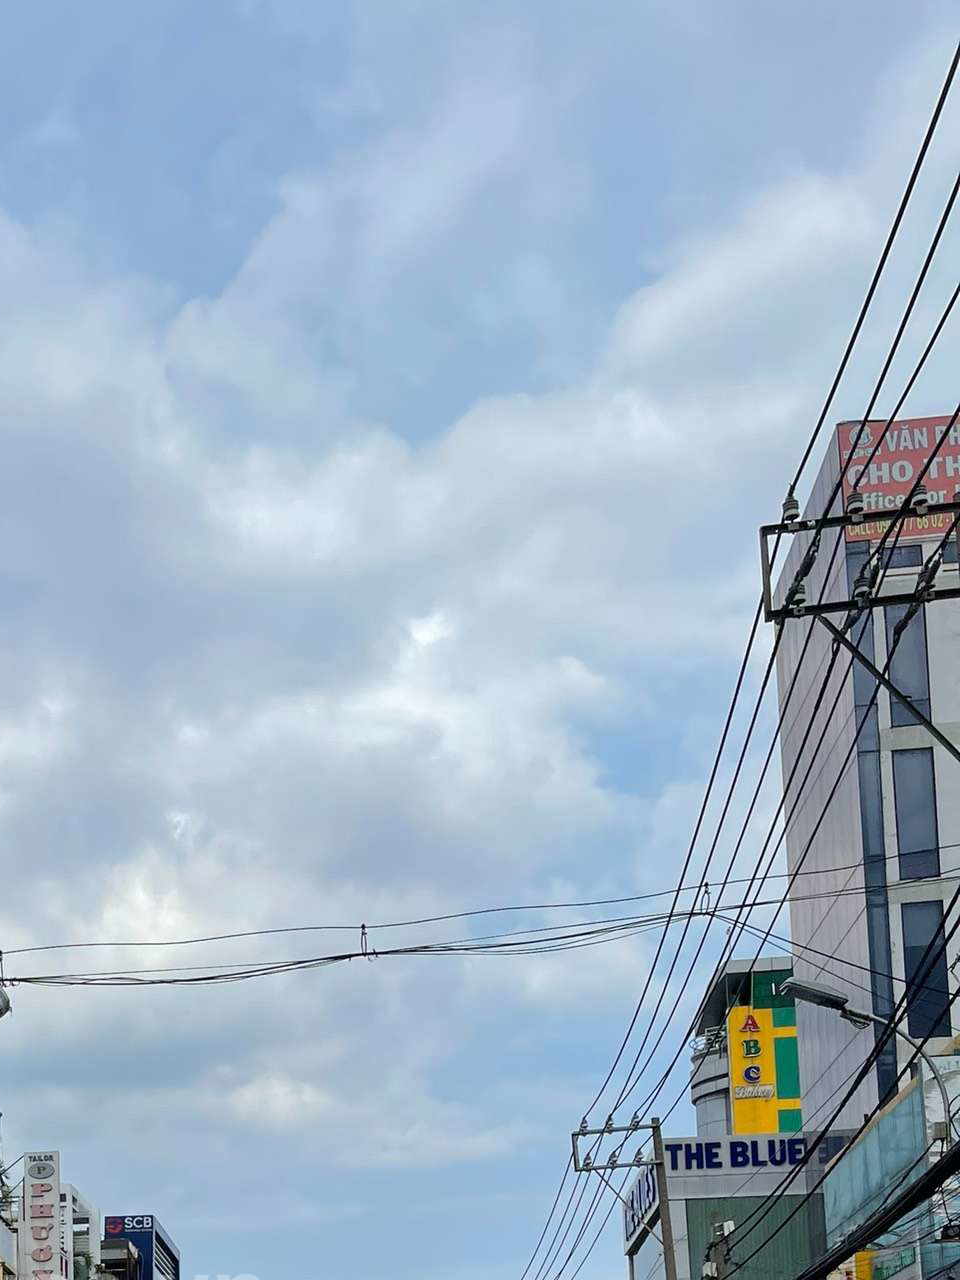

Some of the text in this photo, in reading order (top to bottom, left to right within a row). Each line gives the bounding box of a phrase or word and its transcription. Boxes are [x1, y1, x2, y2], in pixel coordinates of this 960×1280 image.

[885, 425, 929, 452] VĂN
[847, 460, 914, 487] CHO
[848, 491, 906, 511] ffice
[665, 1142, 723, 1171] THE
[730, 1138, 809, 1168] BLUE
[124, 1216, 152, 1228] SCB
